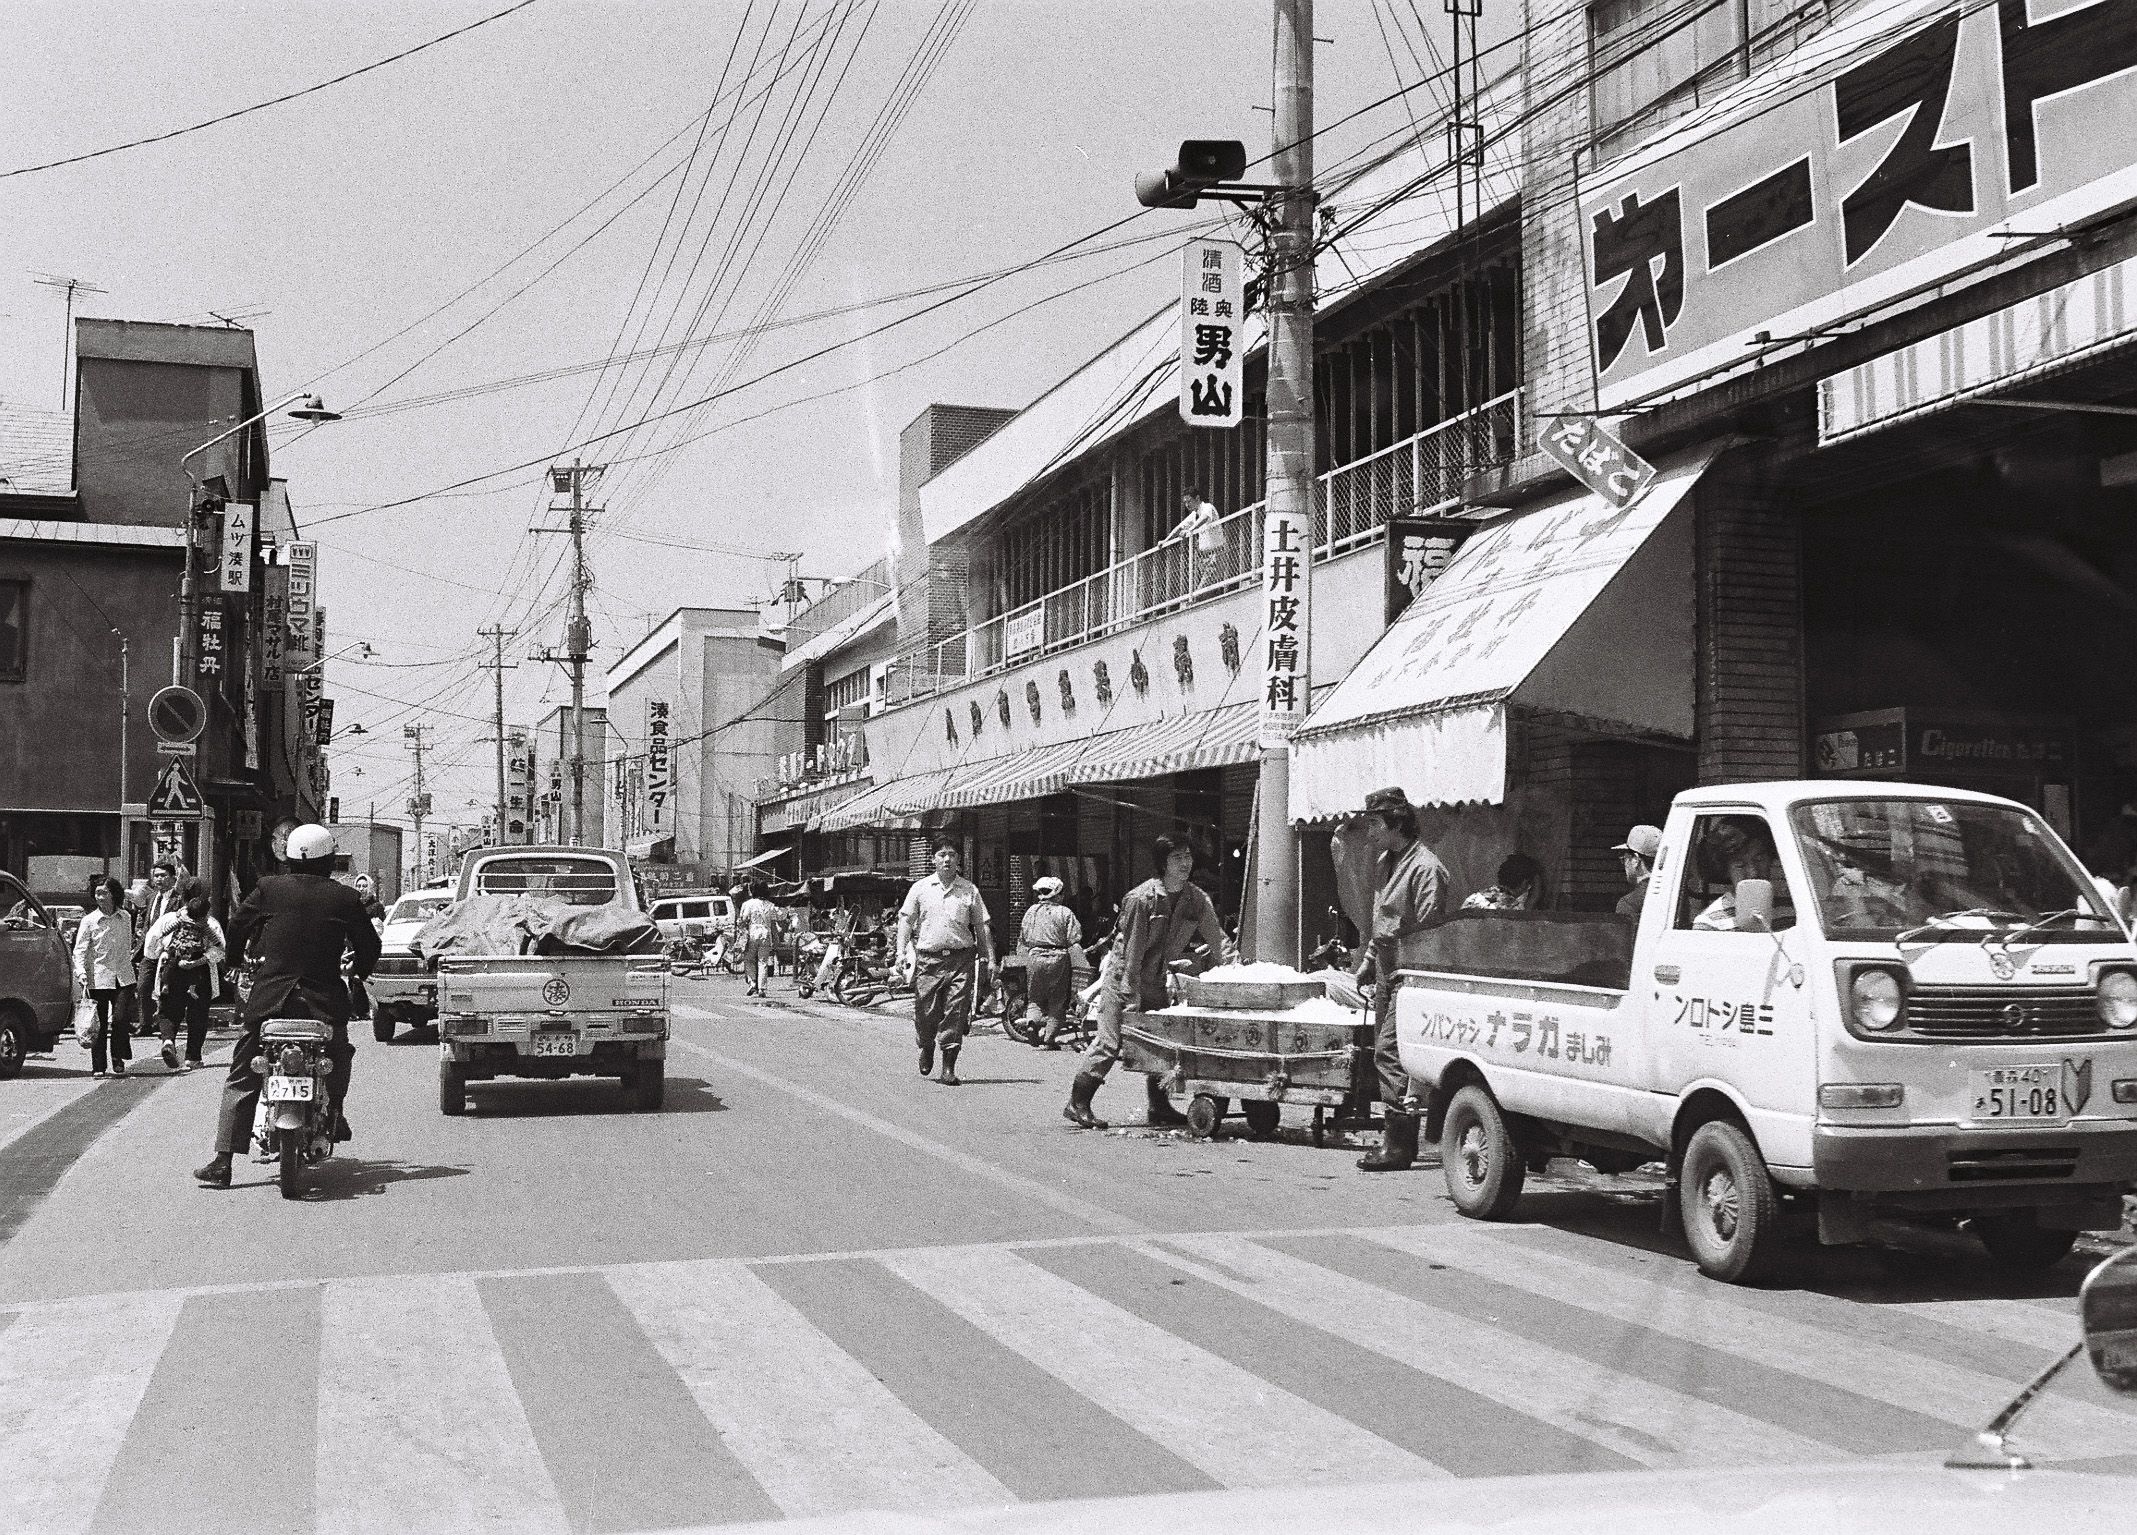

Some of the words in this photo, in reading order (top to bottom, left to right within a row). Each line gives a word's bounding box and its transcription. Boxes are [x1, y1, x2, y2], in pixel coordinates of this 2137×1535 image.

[1202, 249, 1222, 292] 清酒
[1191, 324, 1234, 416] 男山
[1552, 419, 1640, 497] たばこ
[227, 513, 246, 586] ムツ湊駅
[199, 610, 224, 674] 福牡丹
[1266, 519, 1301, 711] 土井皮膚科
[649, 701, 669, 824] 湊食品センター
[536, 1042, 575, 1054] 54-68
[1990, 1088, 2057, 1116] 51-08
